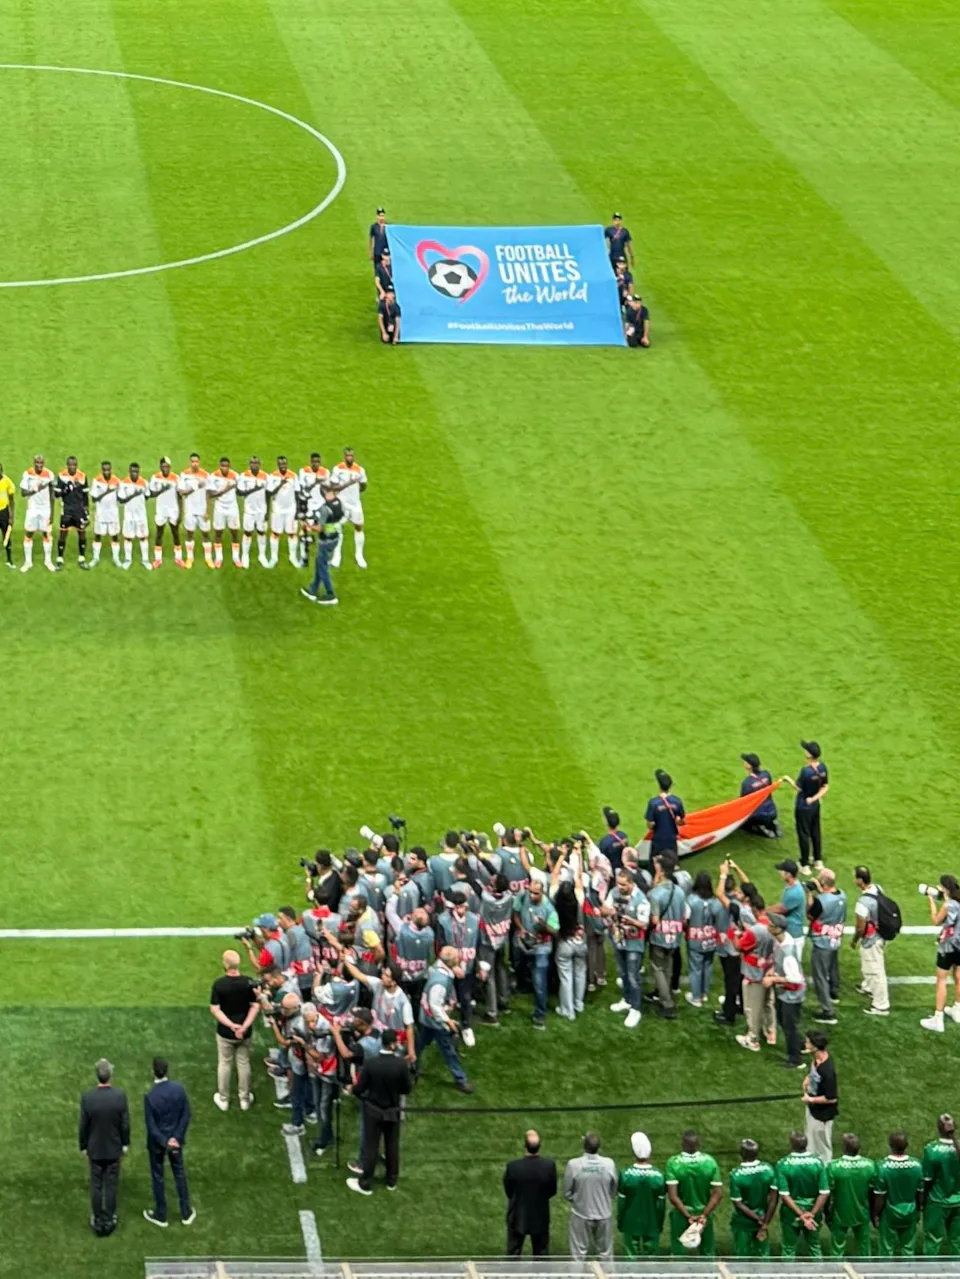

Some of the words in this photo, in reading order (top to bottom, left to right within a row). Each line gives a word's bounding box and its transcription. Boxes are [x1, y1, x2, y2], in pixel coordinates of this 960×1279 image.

[495, 243, 574, 262] FOOTBALL
[498, 260, 580, 283] UNITES
[502, 286, 533, 305] the
[535, 282, 588, 305] World
[447, 321, 575, 331] #FootballUnitesTheWorld
